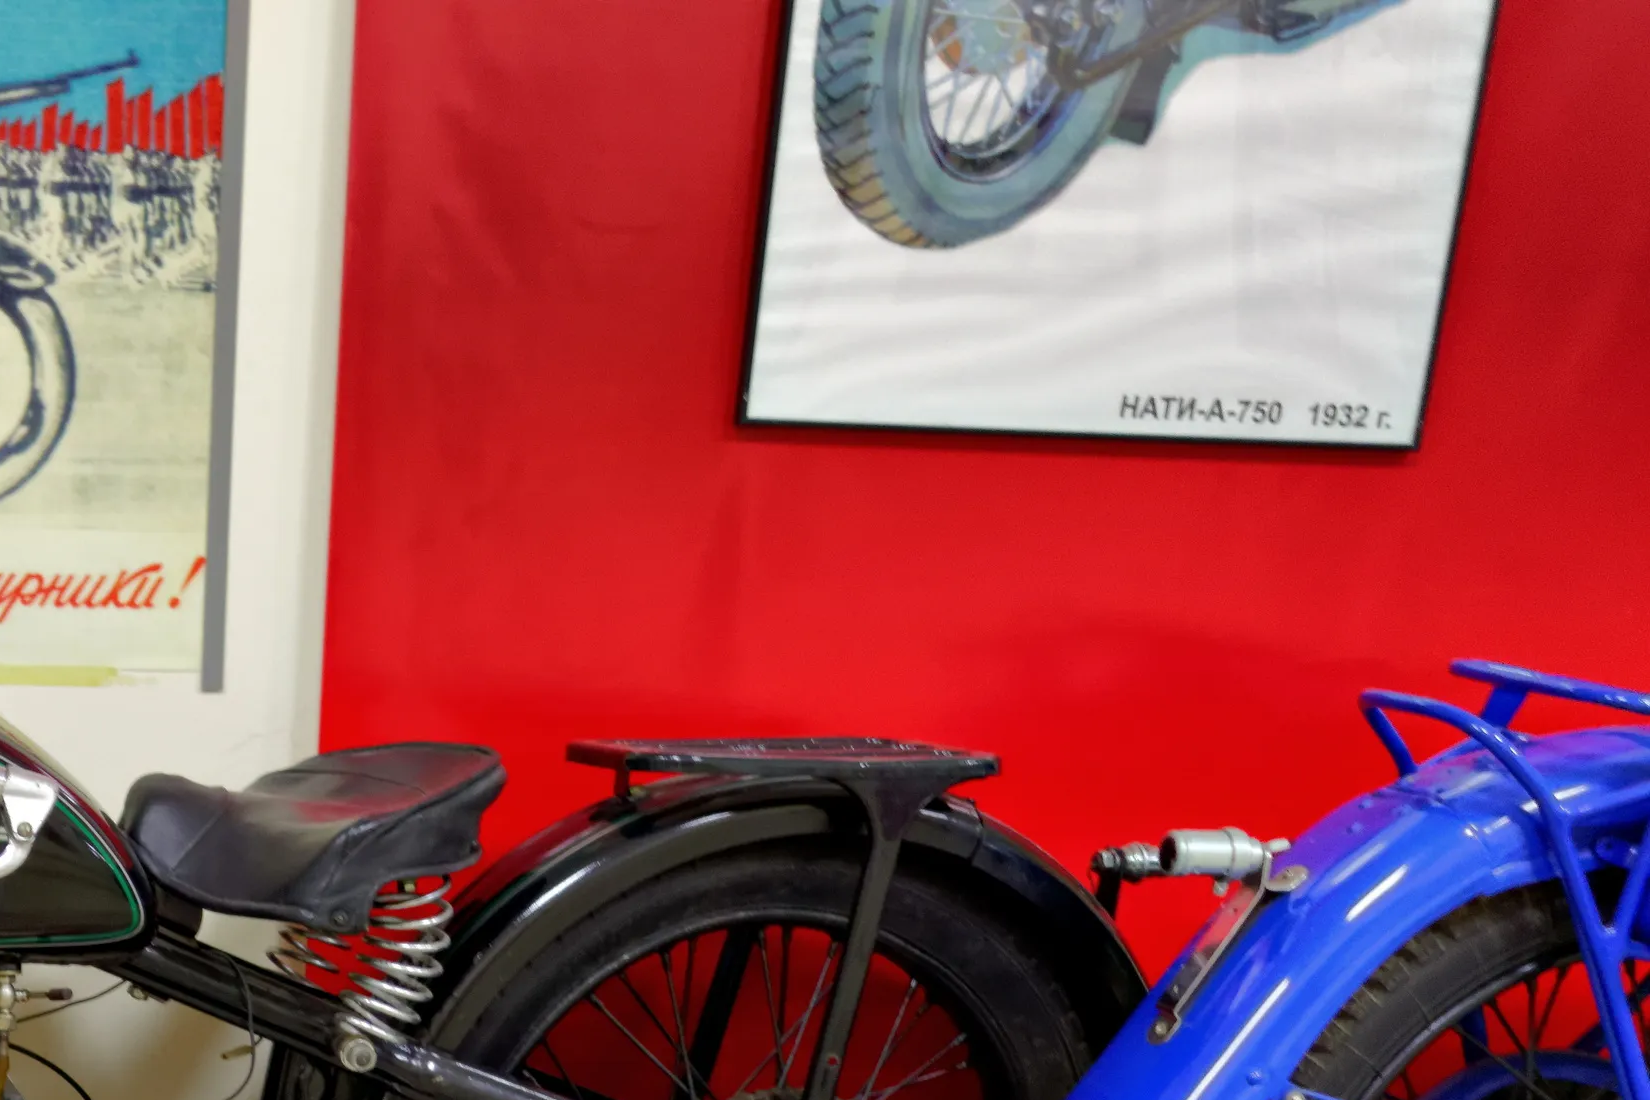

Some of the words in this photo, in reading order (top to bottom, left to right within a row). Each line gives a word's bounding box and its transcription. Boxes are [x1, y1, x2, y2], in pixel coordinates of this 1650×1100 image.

[1119, 394, 1283, 425] НАТИ-А-750
[1308, 402, 1369, 429] 1932
[1376, 410, 1392, 430] г.
